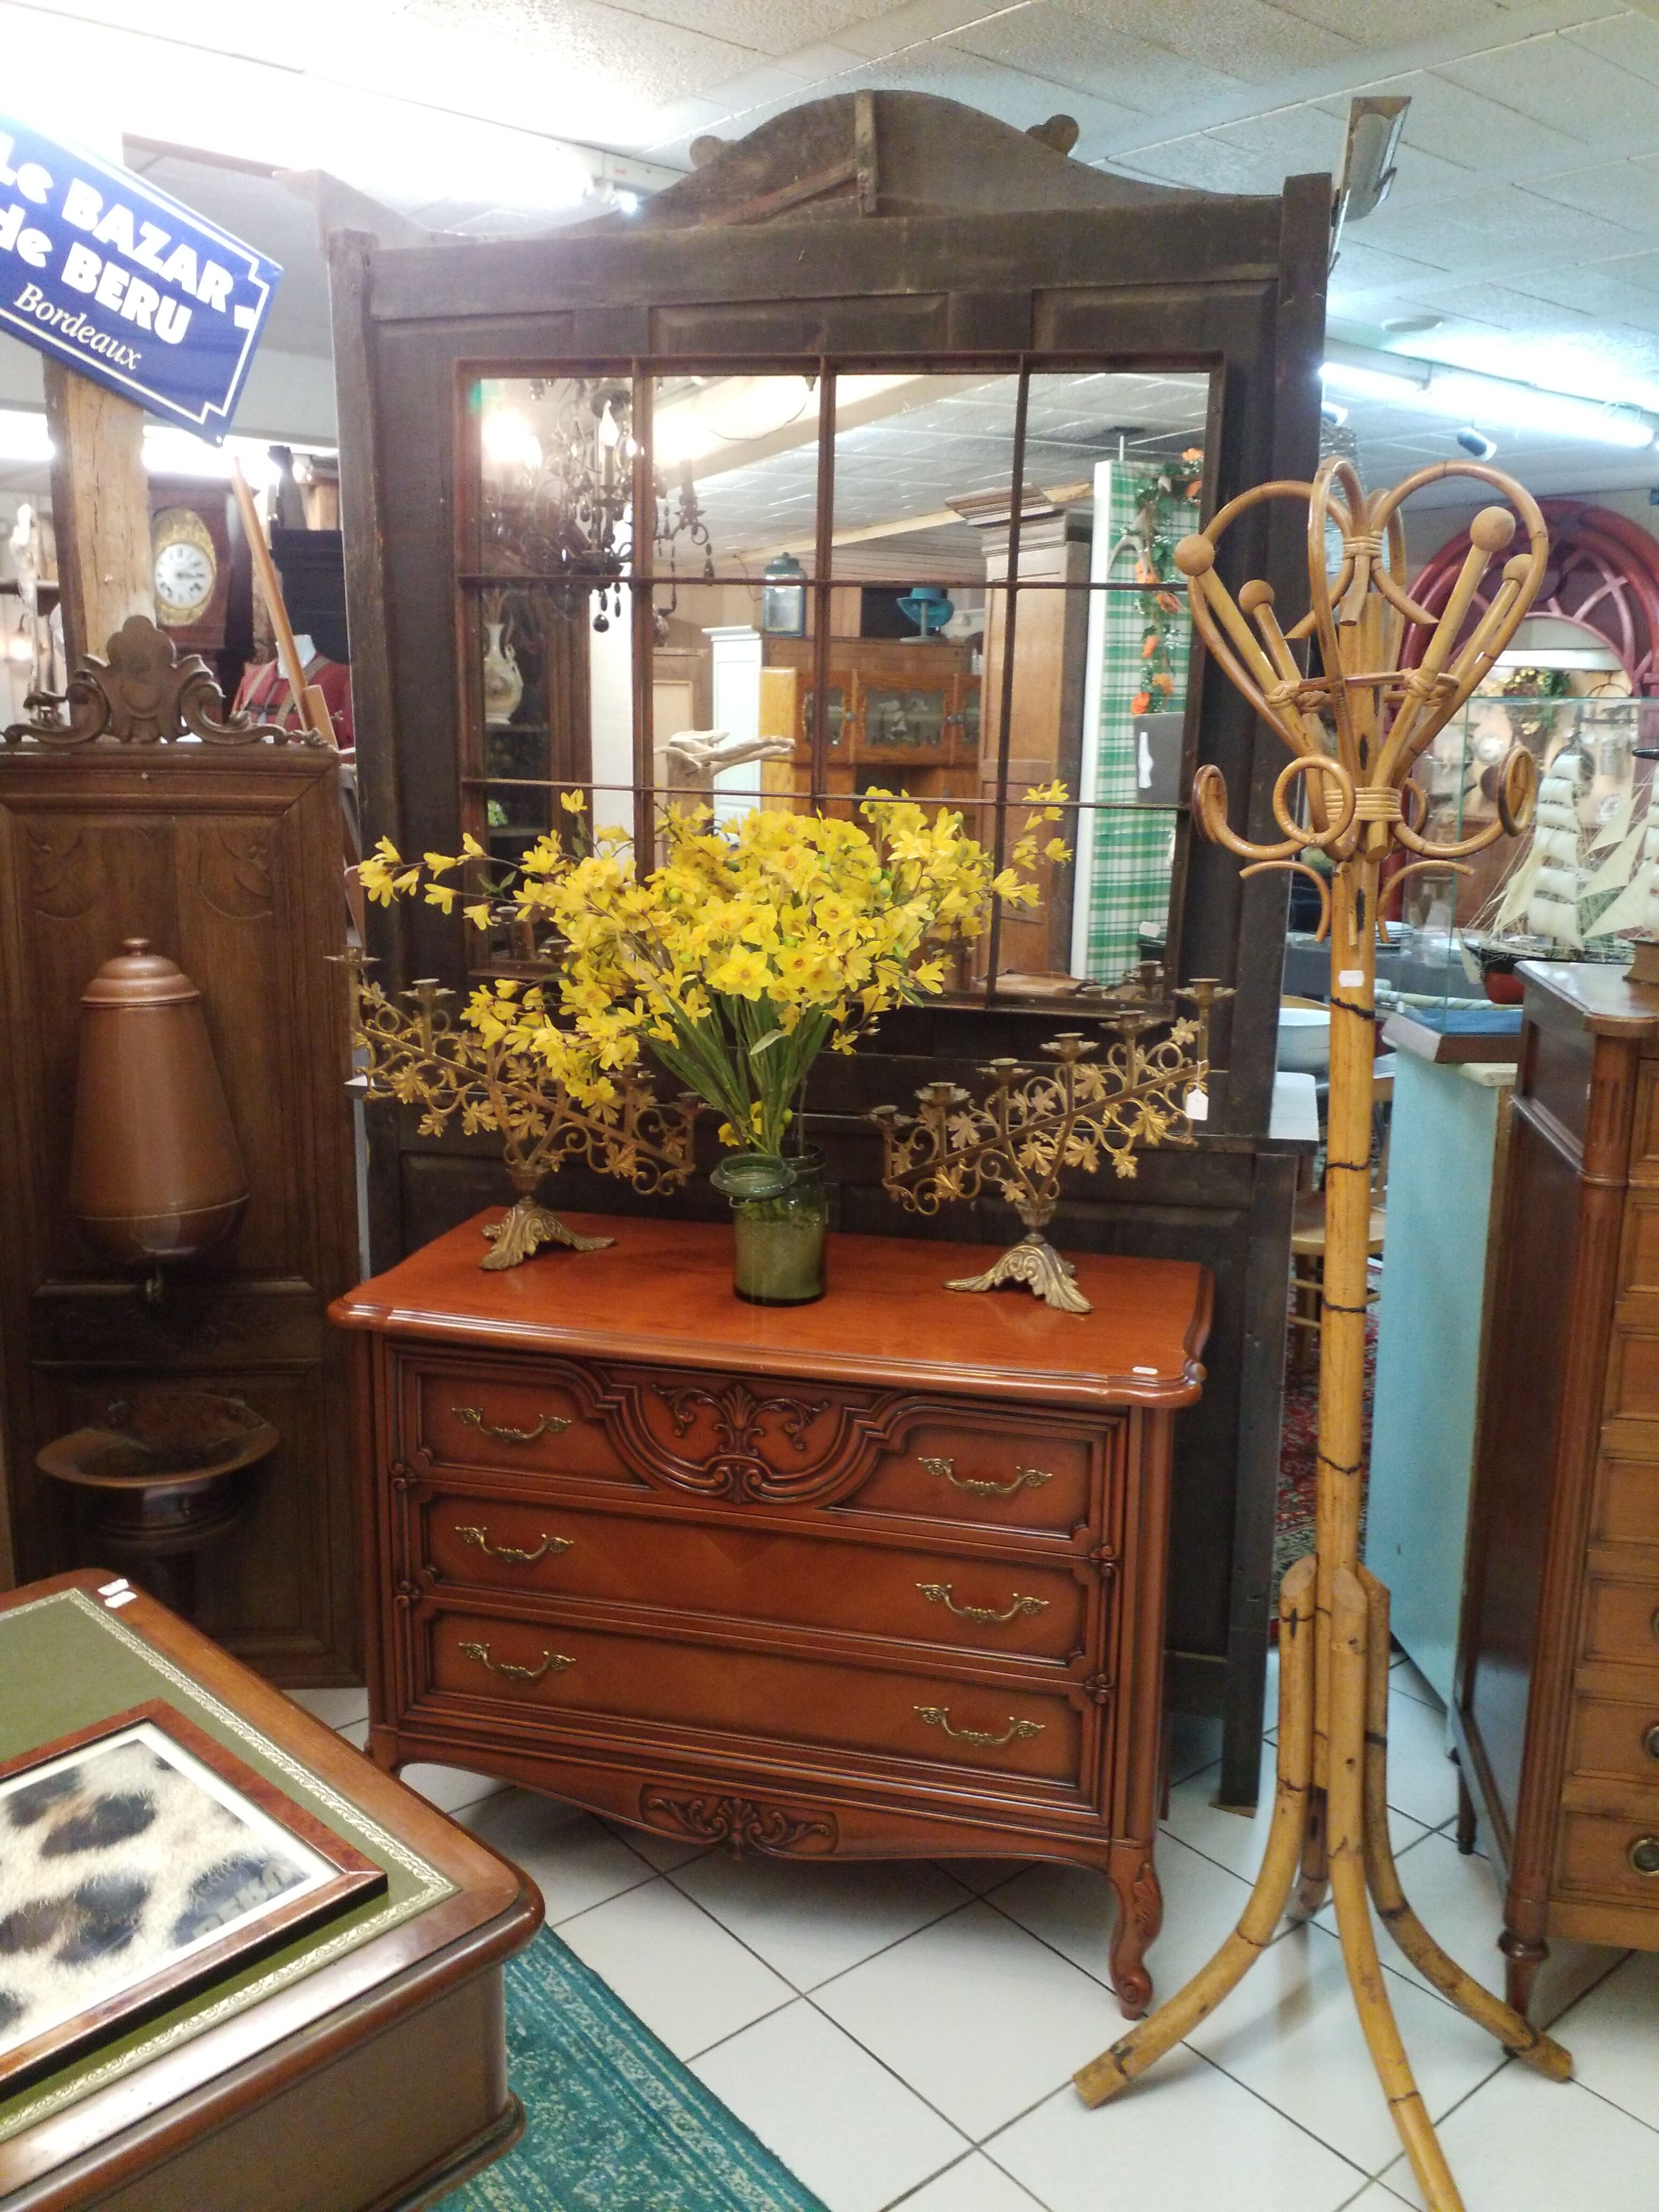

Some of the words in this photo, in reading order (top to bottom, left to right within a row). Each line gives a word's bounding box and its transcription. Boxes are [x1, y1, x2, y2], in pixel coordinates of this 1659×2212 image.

[0, 204, 53, 267] de
[61, 242, 193, 345] BERU
[62, 177, 234, 313] BAZAR
[14, 282, 141, 370] Bordeaux
